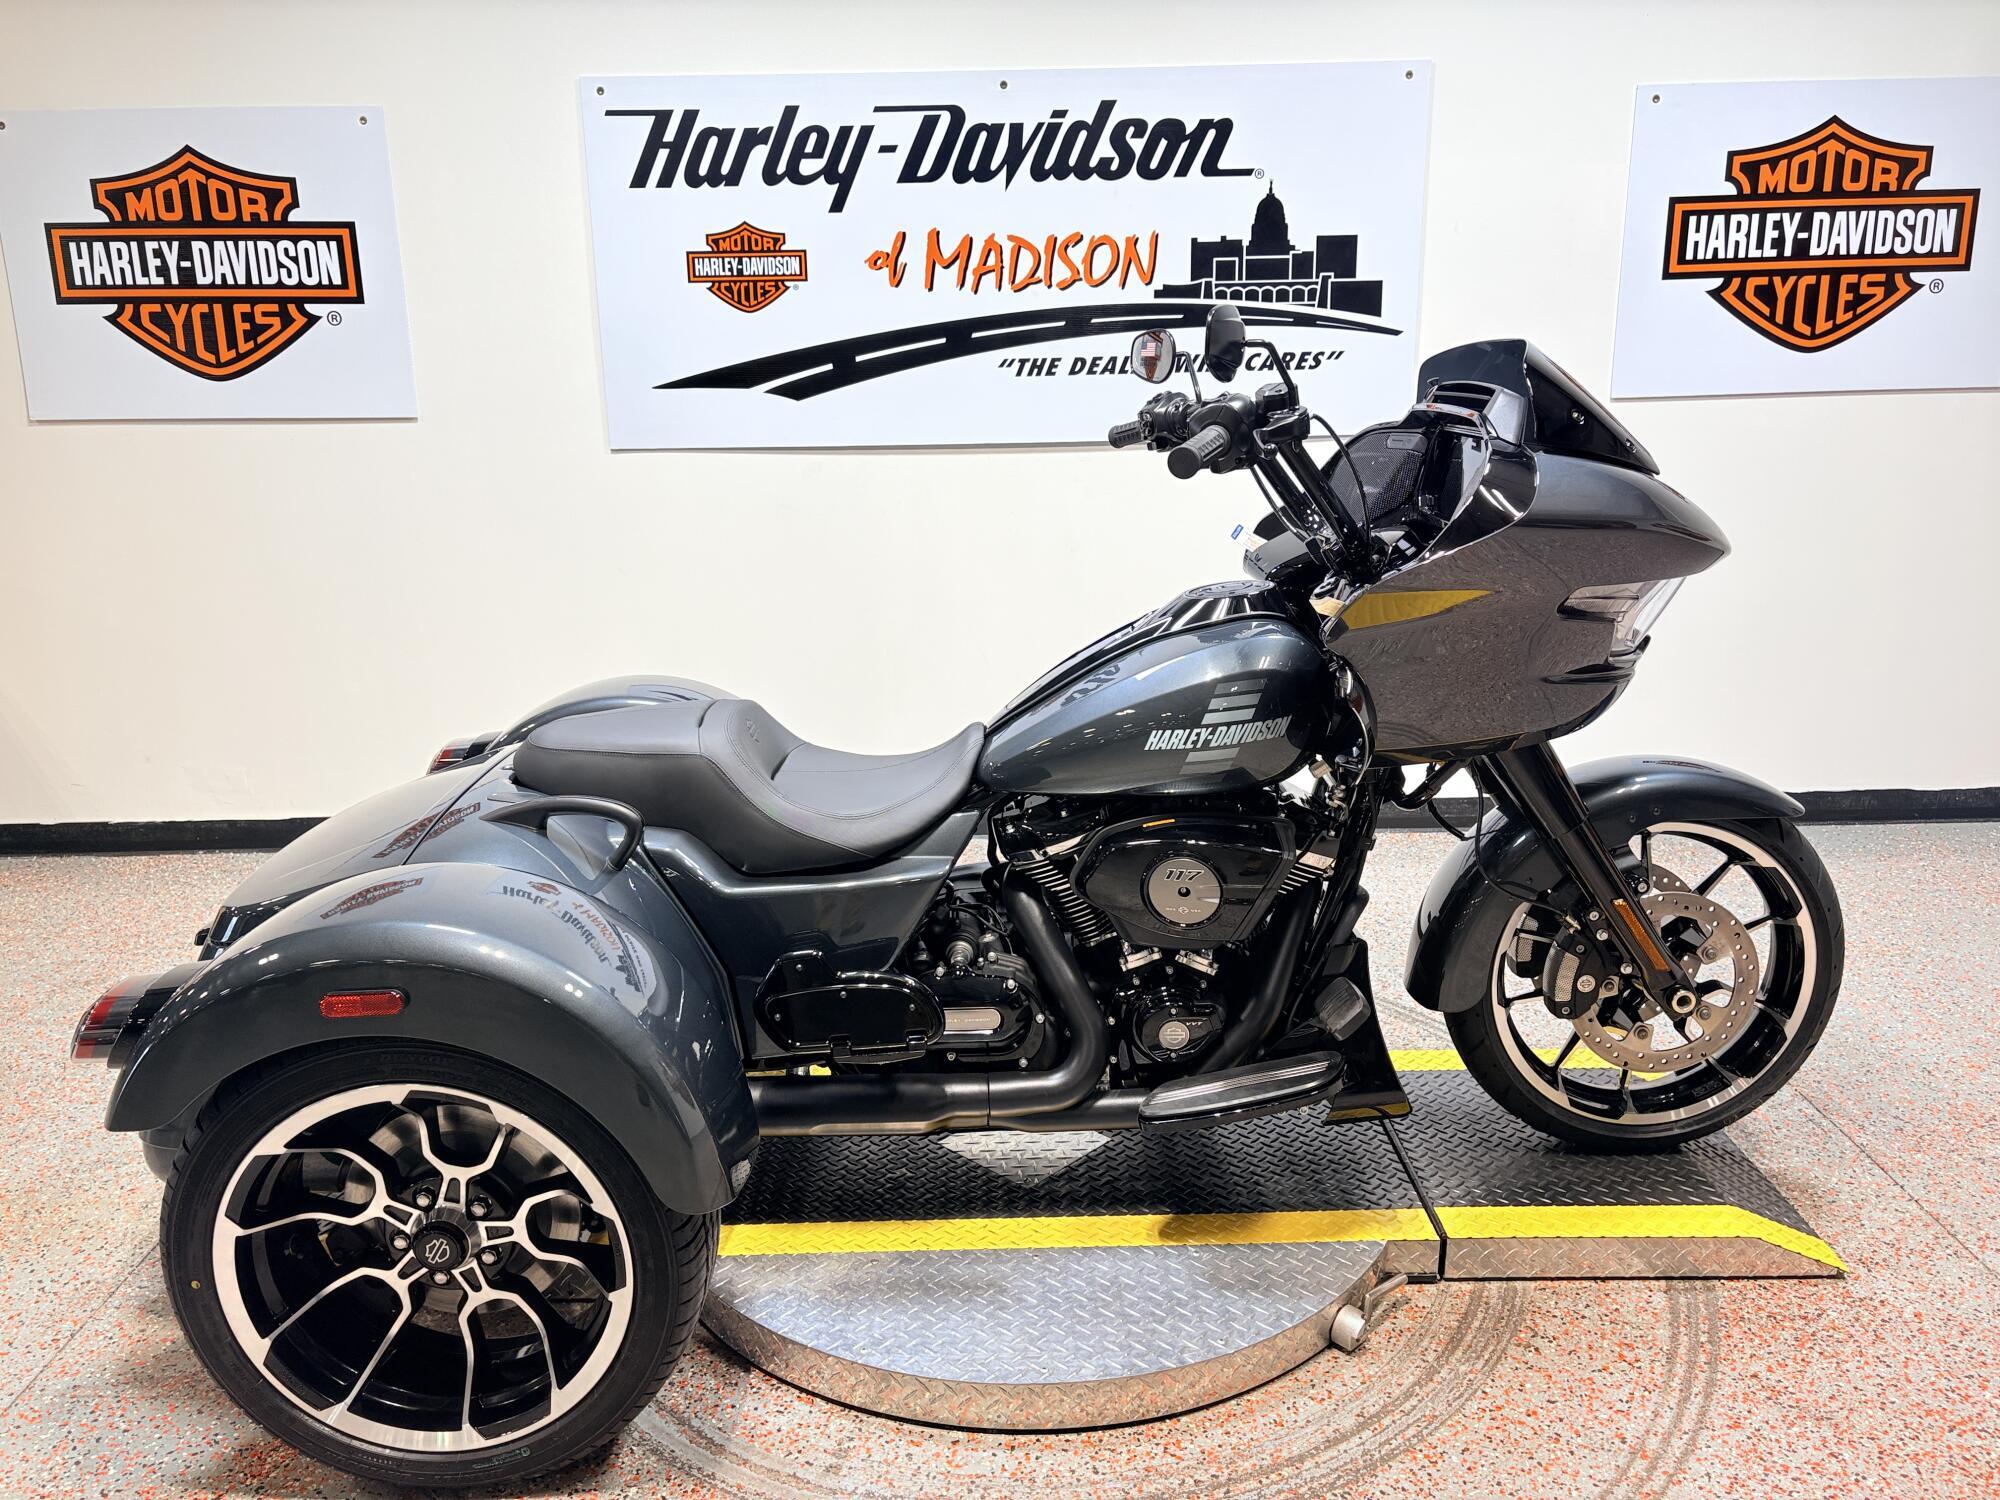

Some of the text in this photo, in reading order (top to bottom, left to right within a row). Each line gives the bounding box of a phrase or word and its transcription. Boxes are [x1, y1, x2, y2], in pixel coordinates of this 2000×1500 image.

[605, 99, 1254, 213] Harley-Davidson
[1757, 138, 1900, 195] MOTOR
[124, 167, 269, 222] MOTOR
[718, 230, 775, 251] MOTOR
[1685, 208, 1958, 261] HARLEY-DAVIDSON
[68, 239, 342, 286] HARLEY-DAVIDSON
[694, 256, 801, 277] HARLEY-DAVIDSON
[865, 227, 1159, 293] of MADISON
[720, 282, 776, 307] CYCLES
[1745, 273, 1887, 337] CYCLES
[139, 303, 282, 365] CYCLES
[1068, 356, 1137, 375] DEAL
[1144, 716, 1292, 751] HARLEY-DAVIDSON
[1164, 868, 1205, 882] 117
